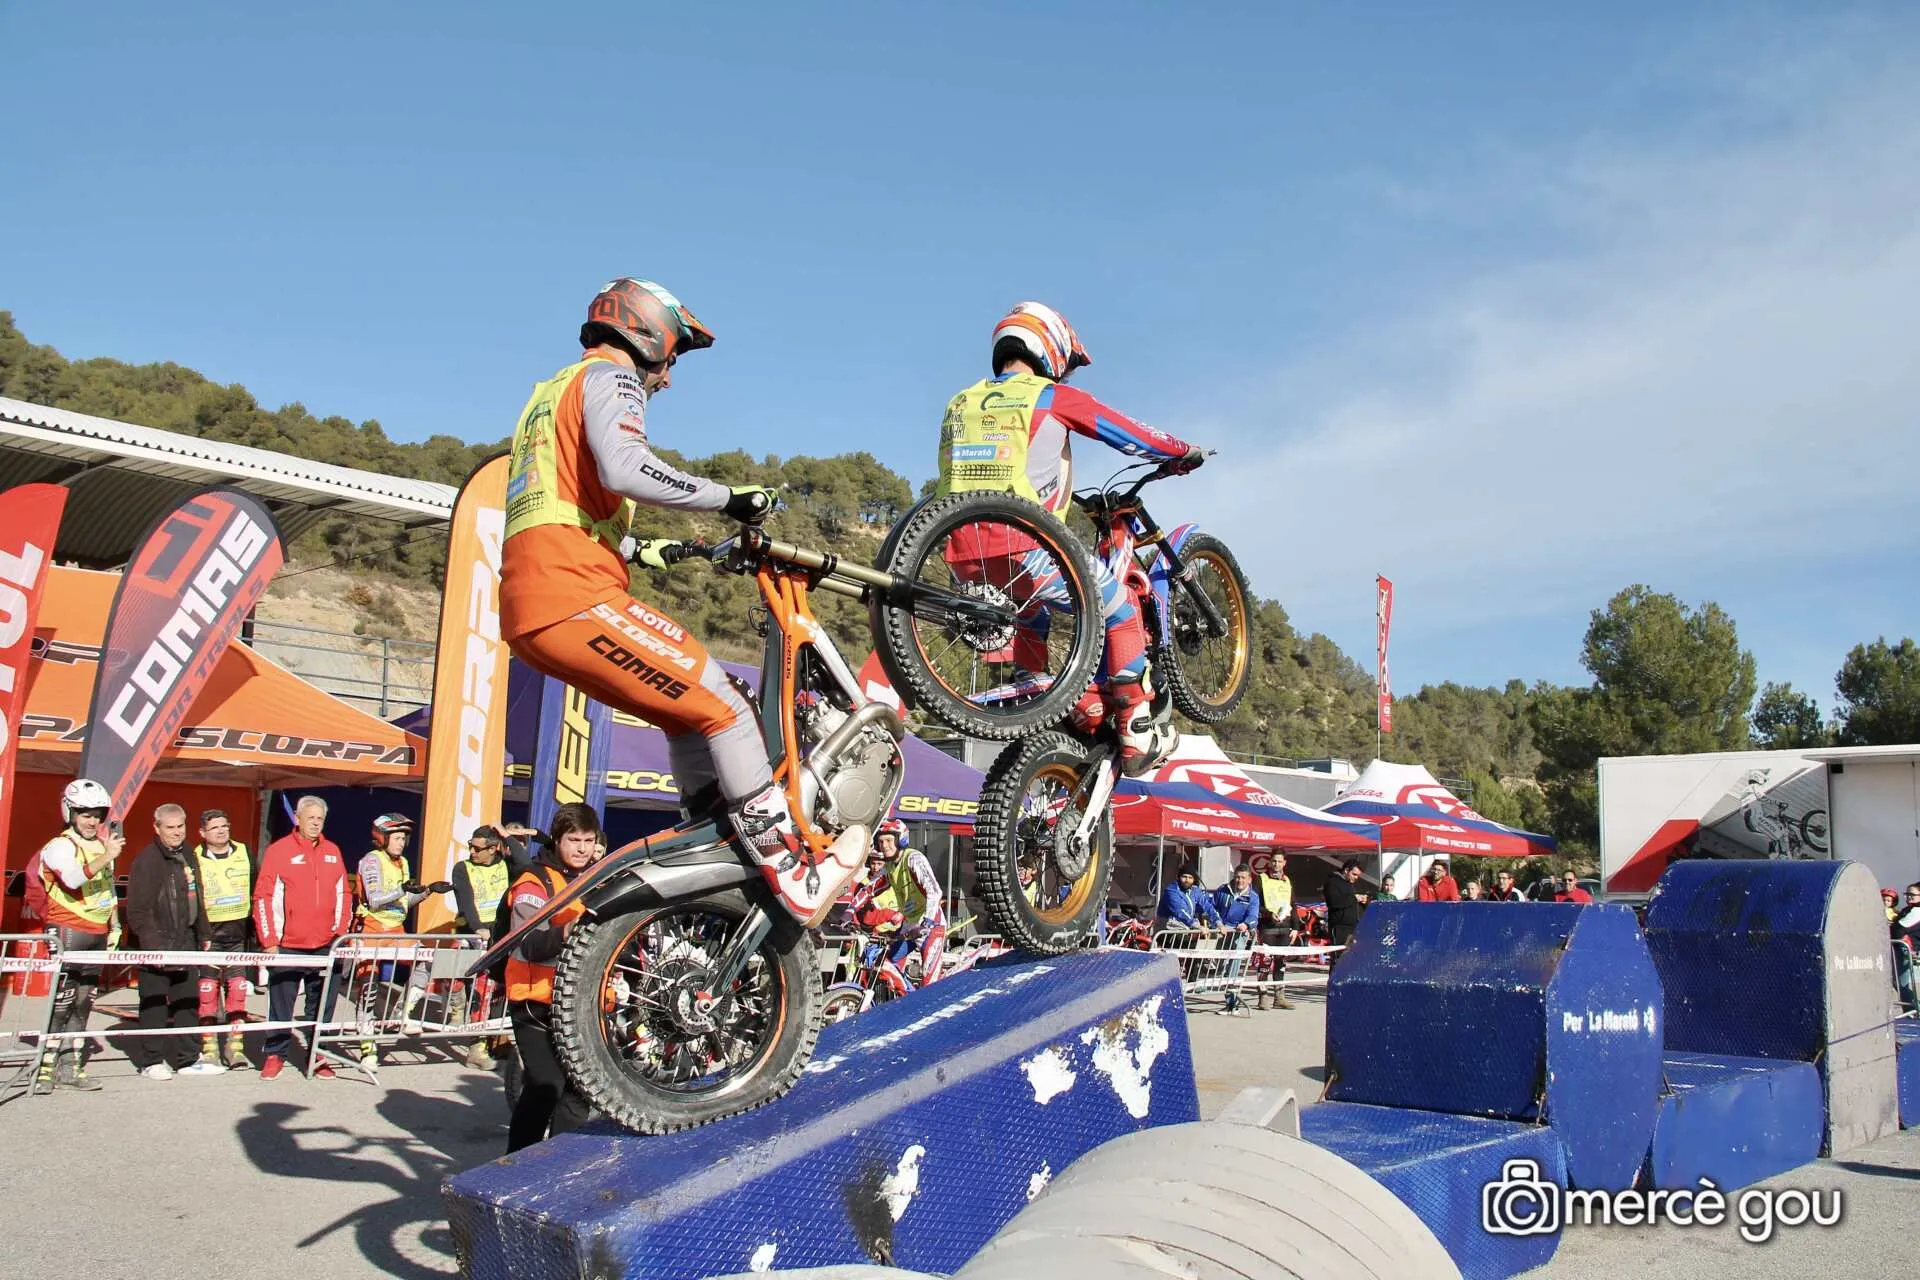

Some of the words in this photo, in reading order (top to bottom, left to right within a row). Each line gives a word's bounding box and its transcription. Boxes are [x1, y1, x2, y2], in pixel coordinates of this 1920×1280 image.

[640, 464, 697, 493] COMAS
[103, 509, 268, 748] COMAS
[591, 603, 697, 671] SCORPA
[627, 604, 685, 642] MOTUL
[587, 634, 691, 700] COMAS
[173, 726, 417, 767] SCORPA
[113, 758, 149, 817] IME
[108, 951, 163, 966] octagon
[225, 954, 276, 966] octagon
[1563, 1011, 1583, 1032] Per
